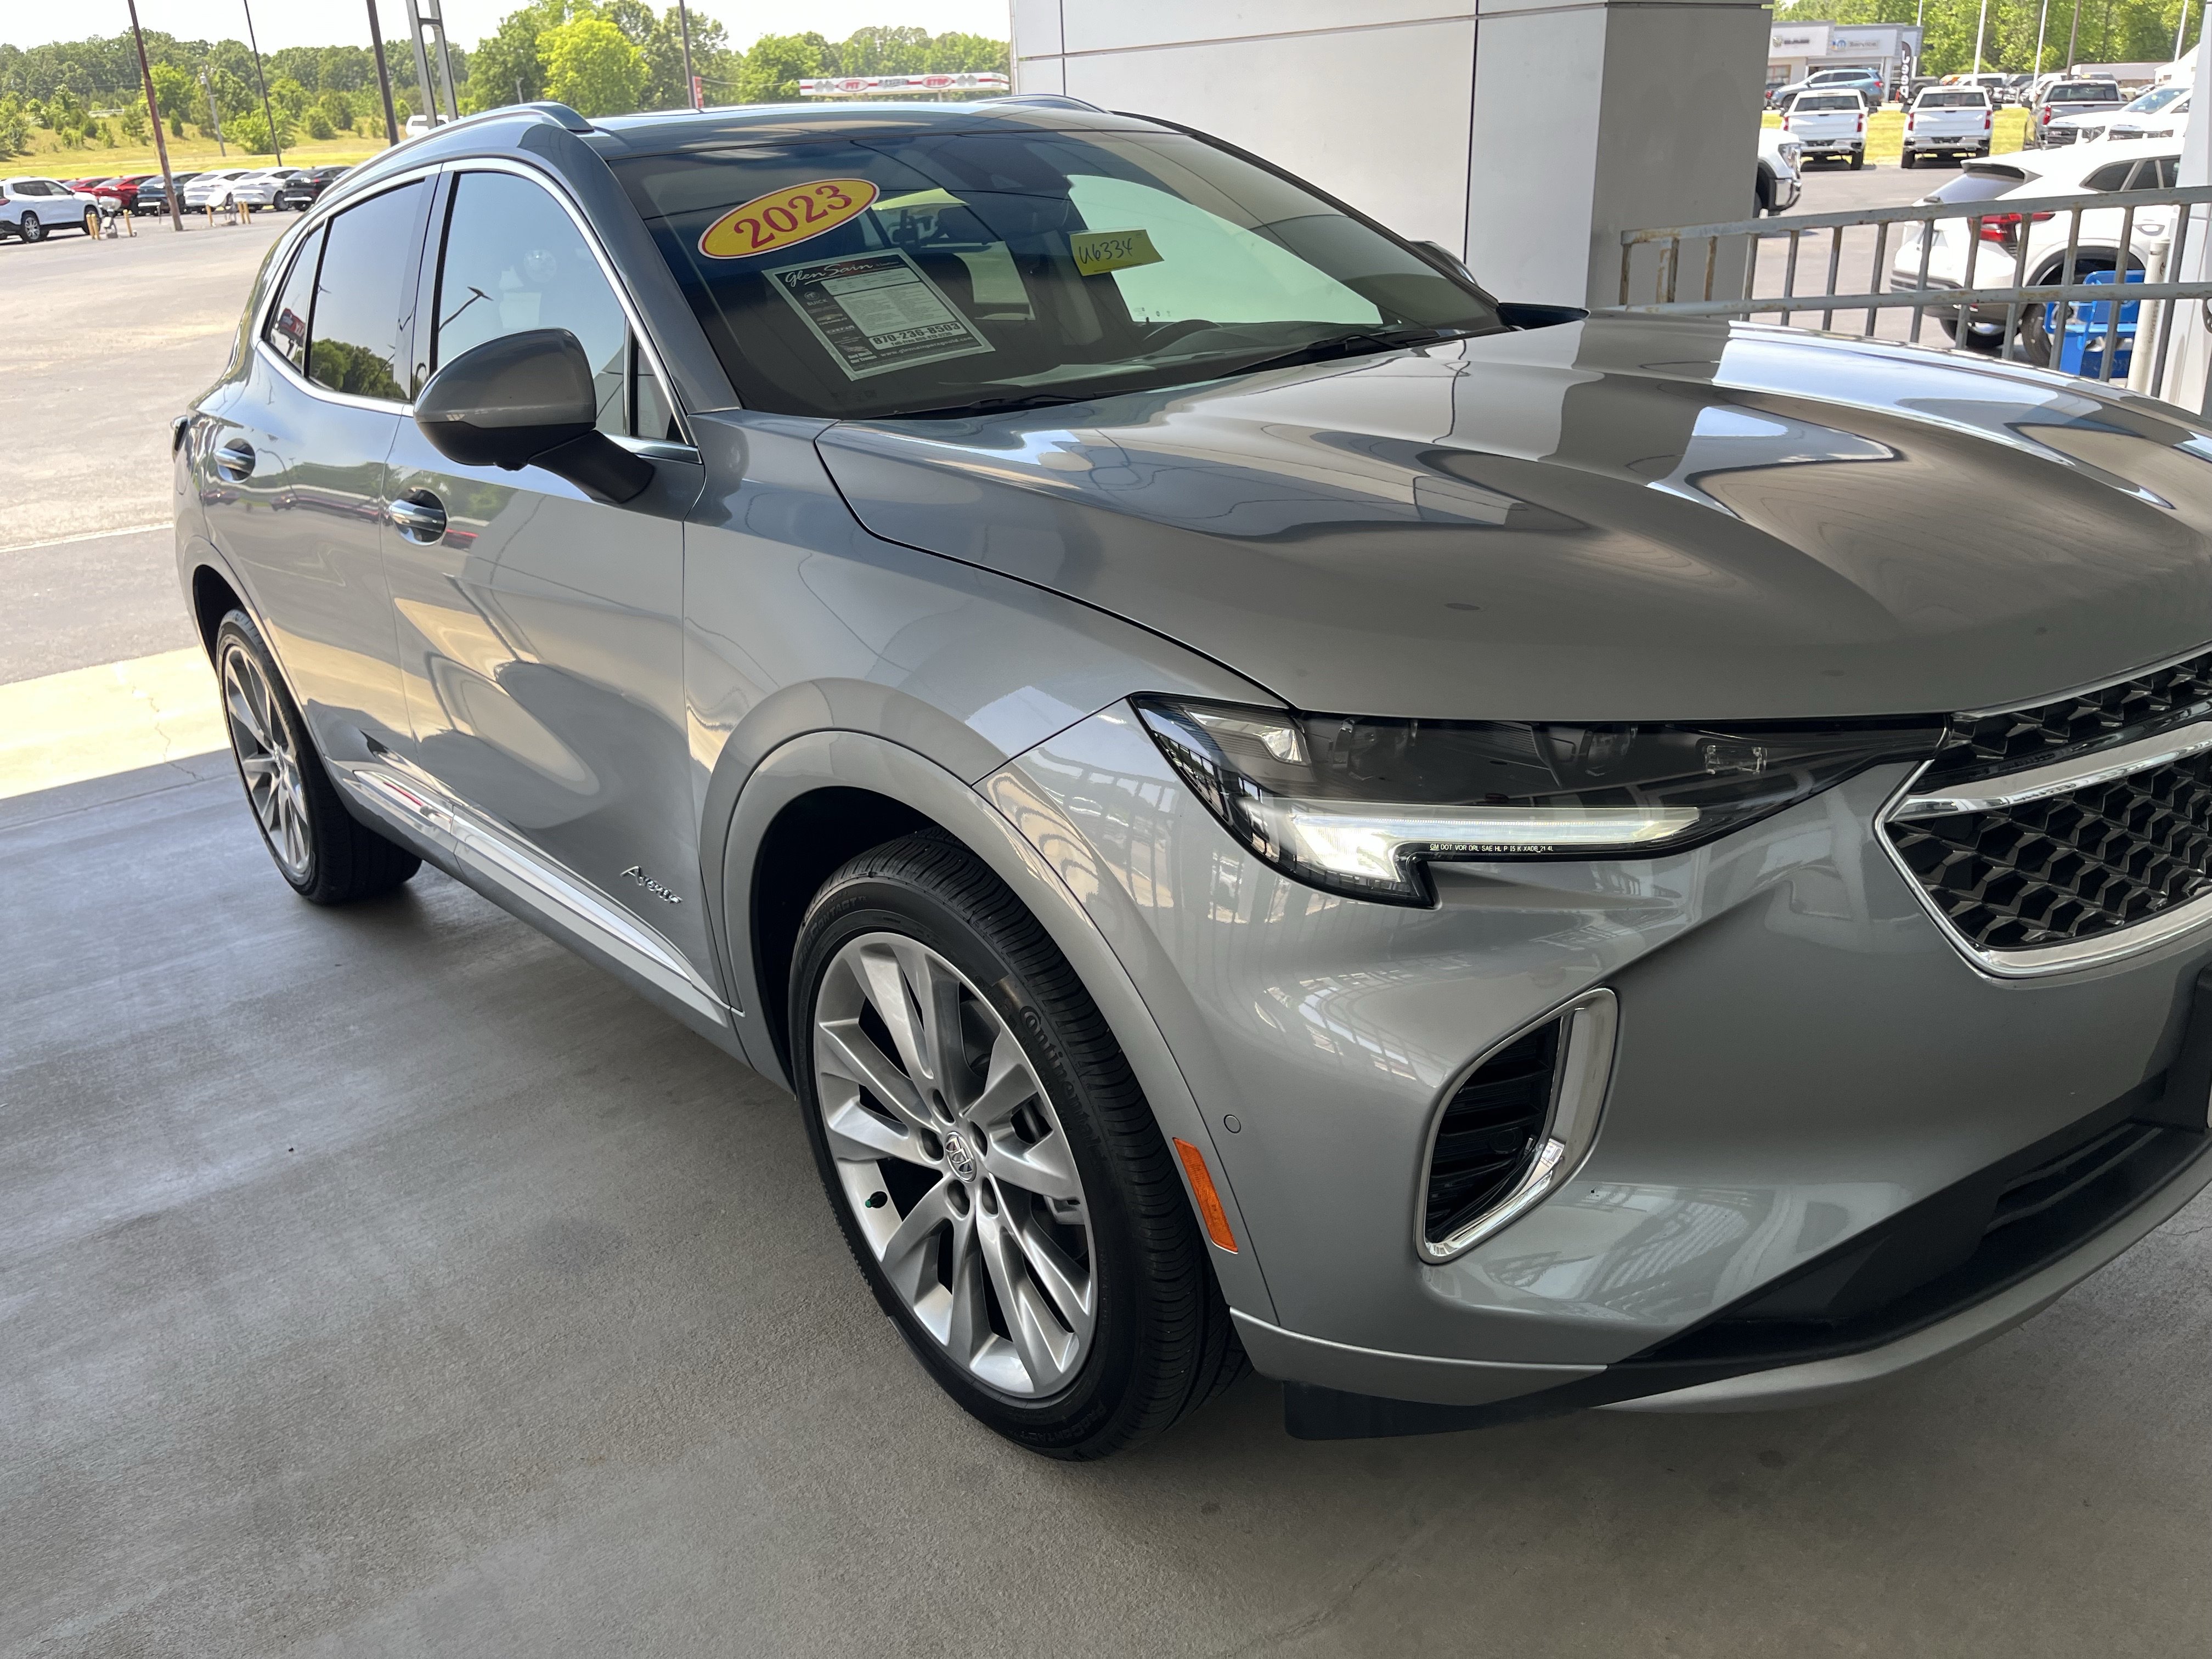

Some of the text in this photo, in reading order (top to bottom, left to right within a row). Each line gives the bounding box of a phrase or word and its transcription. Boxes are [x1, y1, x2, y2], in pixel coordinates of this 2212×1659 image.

[733, 185, 853, 250] 2023
[785, 270, 826, 287] Glen
[872, 323, 961, 345] 870-236-8503
[1020, 1005, 1102, 1148] Continental
